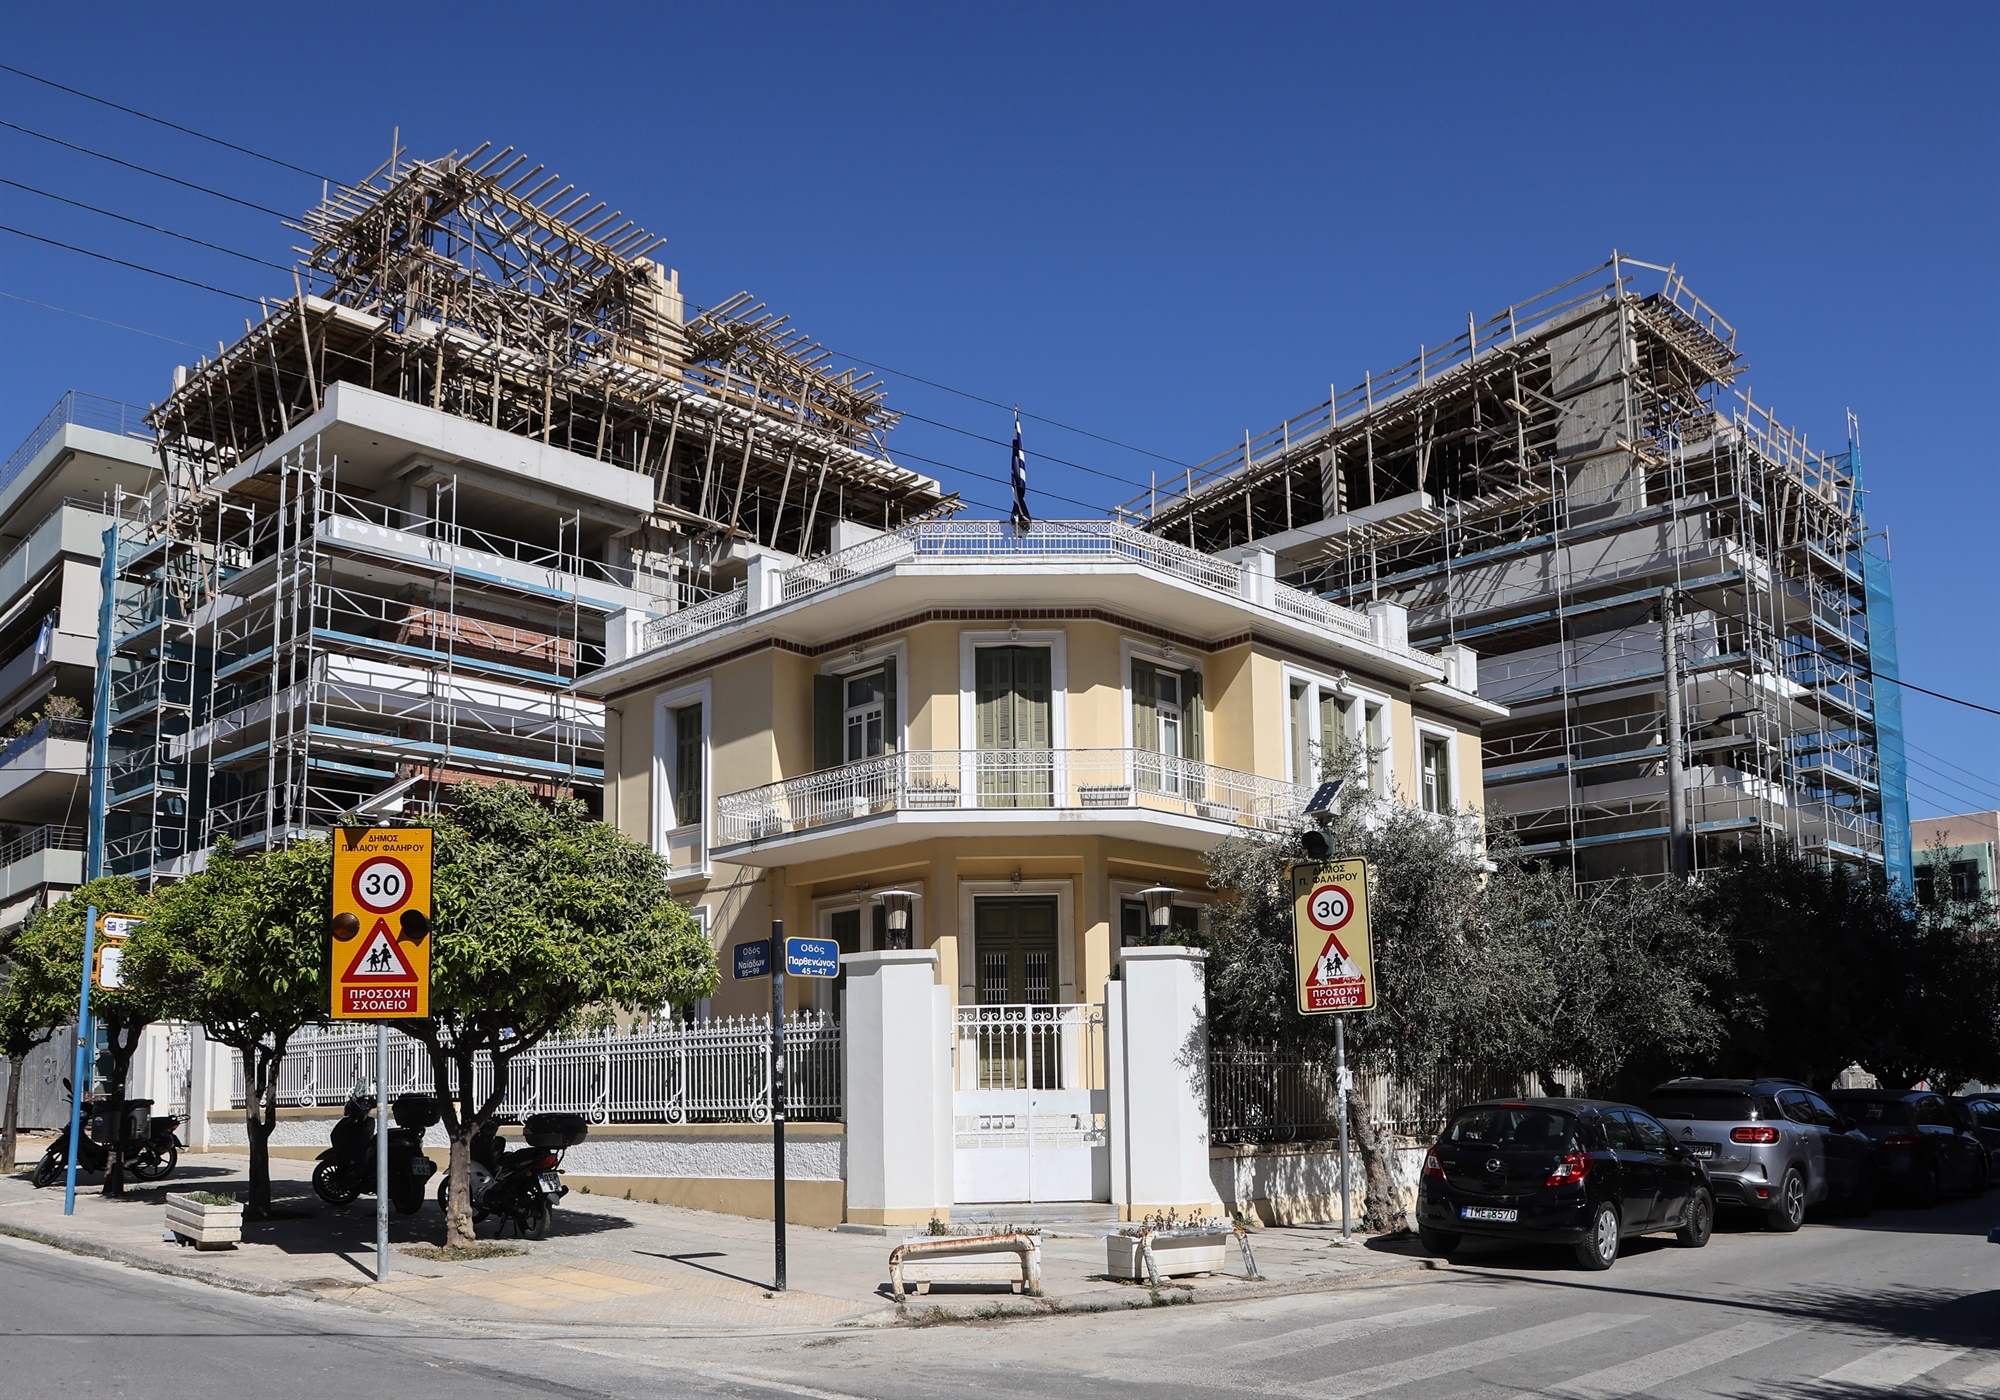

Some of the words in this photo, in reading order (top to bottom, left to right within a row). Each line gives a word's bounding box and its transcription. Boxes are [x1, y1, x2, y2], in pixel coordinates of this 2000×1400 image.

[368, 834, 399, 842] ΔΗΜΟΣ
[341, 844, 378, 852] ΠΑΛΑΙΟΥ
[382, 844, 424, 852] ΦΑΛΗΡΟΥ
[1312, 865, 1346, 876] ΔΗΜΟΣ
[365, 873, 400, 896] 30
[1312, 873, 1358, 885] ΦΑΛΗΡΟΥ
[1317, 900, 1344, 918] 30
[742, 946, 761, 956] Οδός
[800, 943, 825, 955] Οδός
[788, 956, 836, 969] Παρθενώνος
[349, 989, 411, 999] ΠΡΟΣΟΧΗ
[1312, 986, 1360, 998] ΠΡΟΣΟΧΗ
[352, 1000, 408, 1010] ΣΧΟΛΕΙΟ
[1315, 995, 1358, 1006] ΣΧΟΛΕΙΟ
